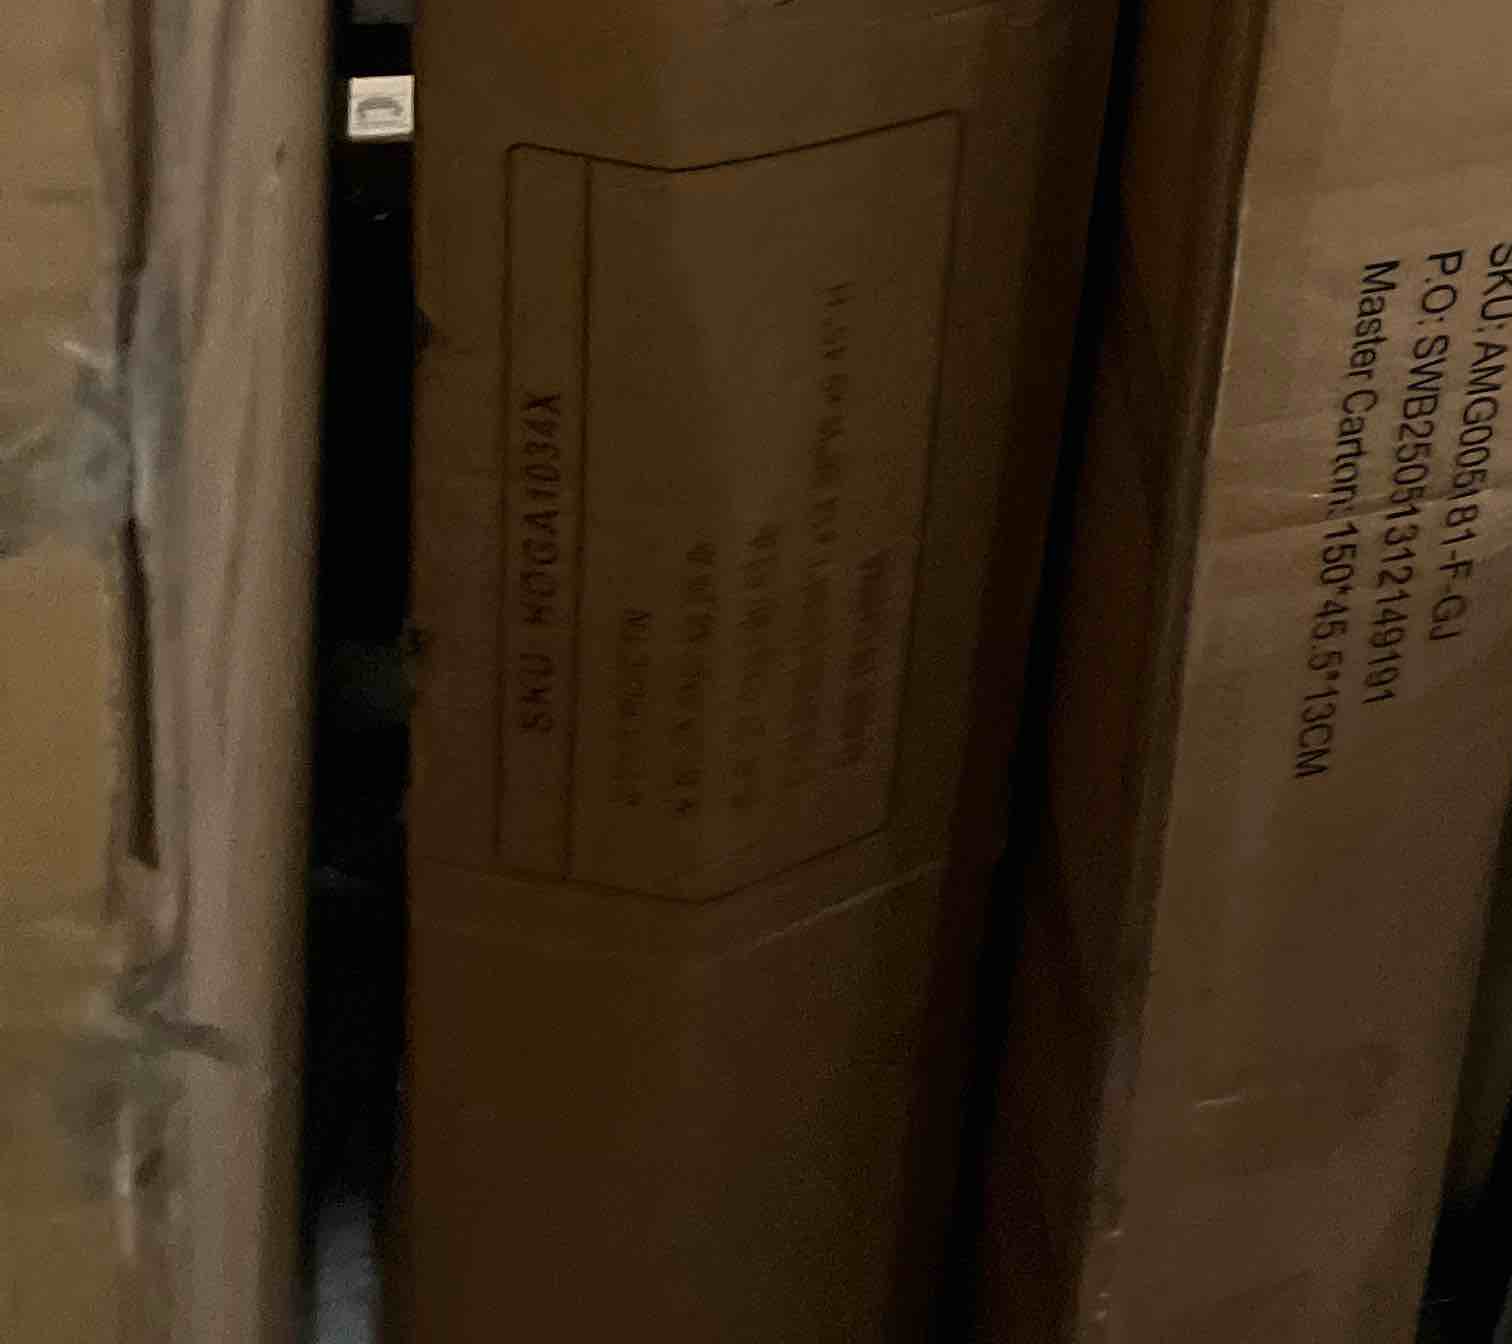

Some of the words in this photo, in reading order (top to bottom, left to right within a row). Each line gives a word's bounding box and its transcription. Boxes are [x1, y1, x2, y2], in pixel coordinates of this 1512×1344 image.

[1347, 260, 1401, 379] Master
[1416, 249, 1467, 326] P.O:
[1328, 389, 1379, 513] Carton:
